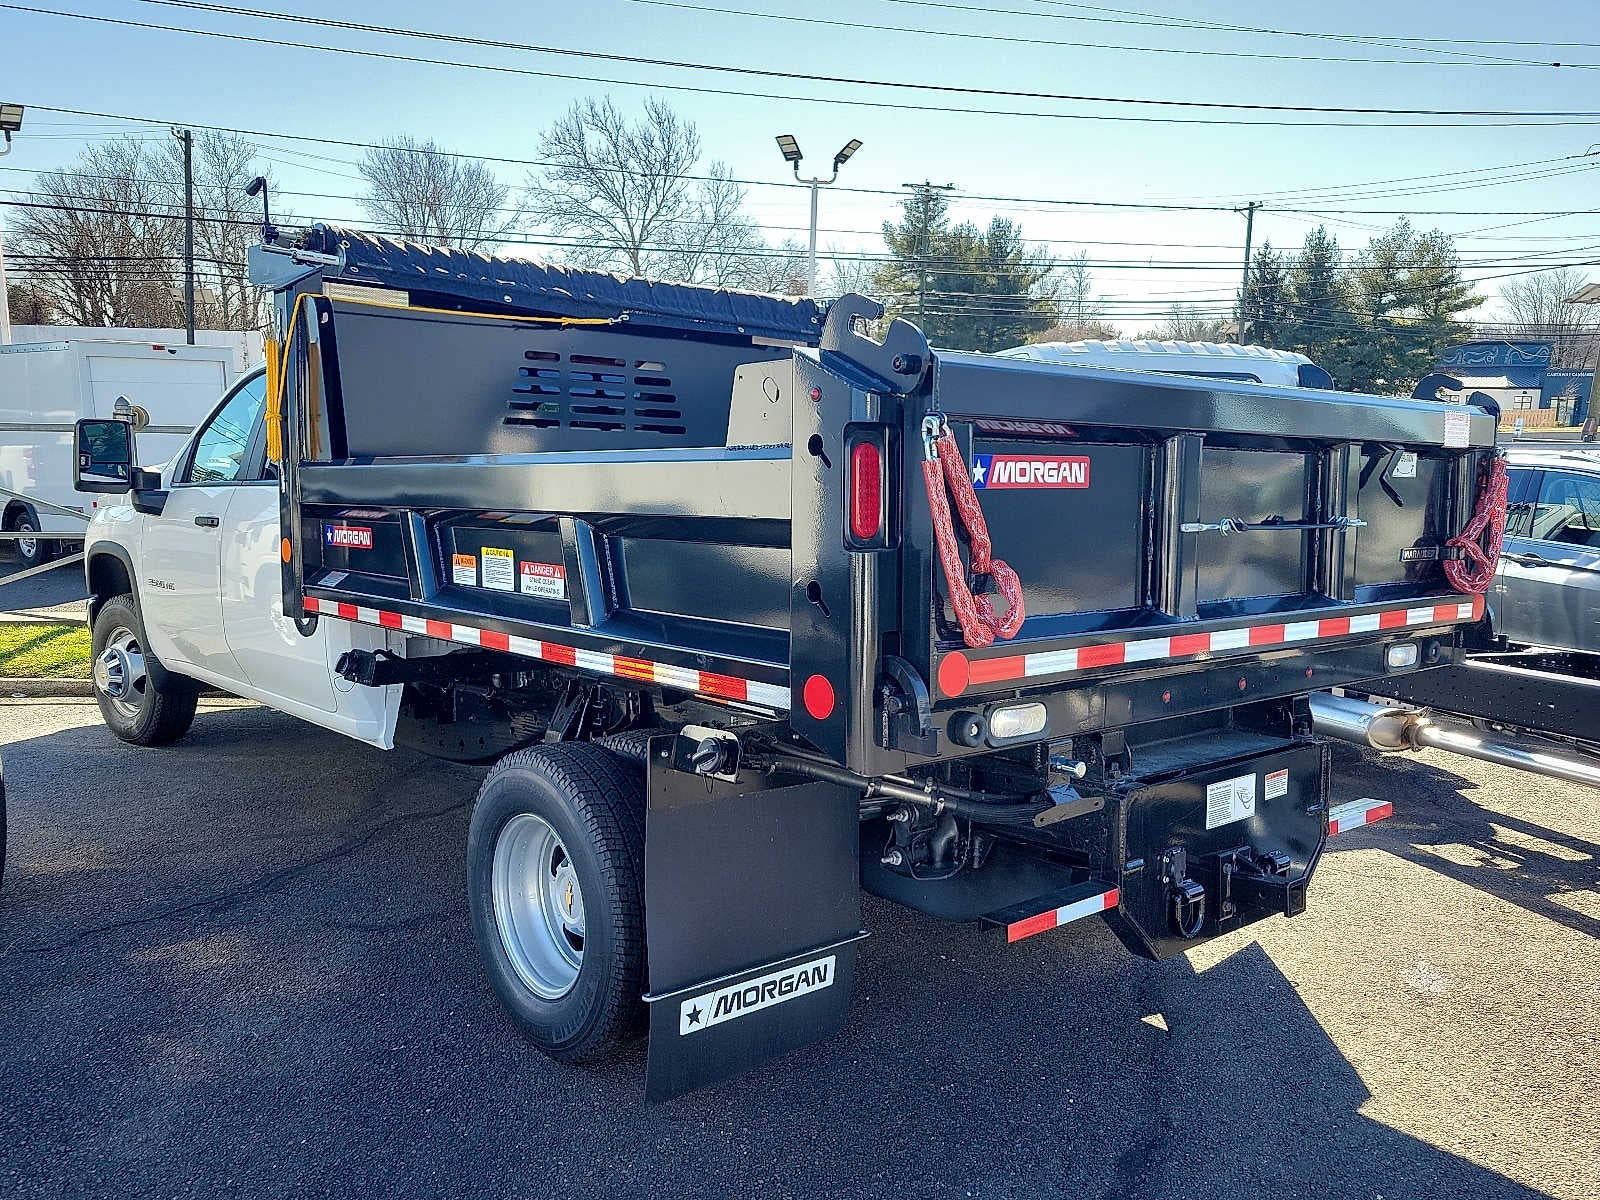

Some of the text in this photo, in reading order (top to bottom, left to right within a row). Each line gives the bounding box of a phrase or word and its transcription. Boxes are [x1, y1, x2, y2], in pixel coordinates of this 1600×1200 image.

[992, 461, 1086, 483] MORGAN
[334, 529, 370, 546] MORGAN
[530, 564, 554, 576] DANGER
[713, 964, 828, 1019] MORGAN
